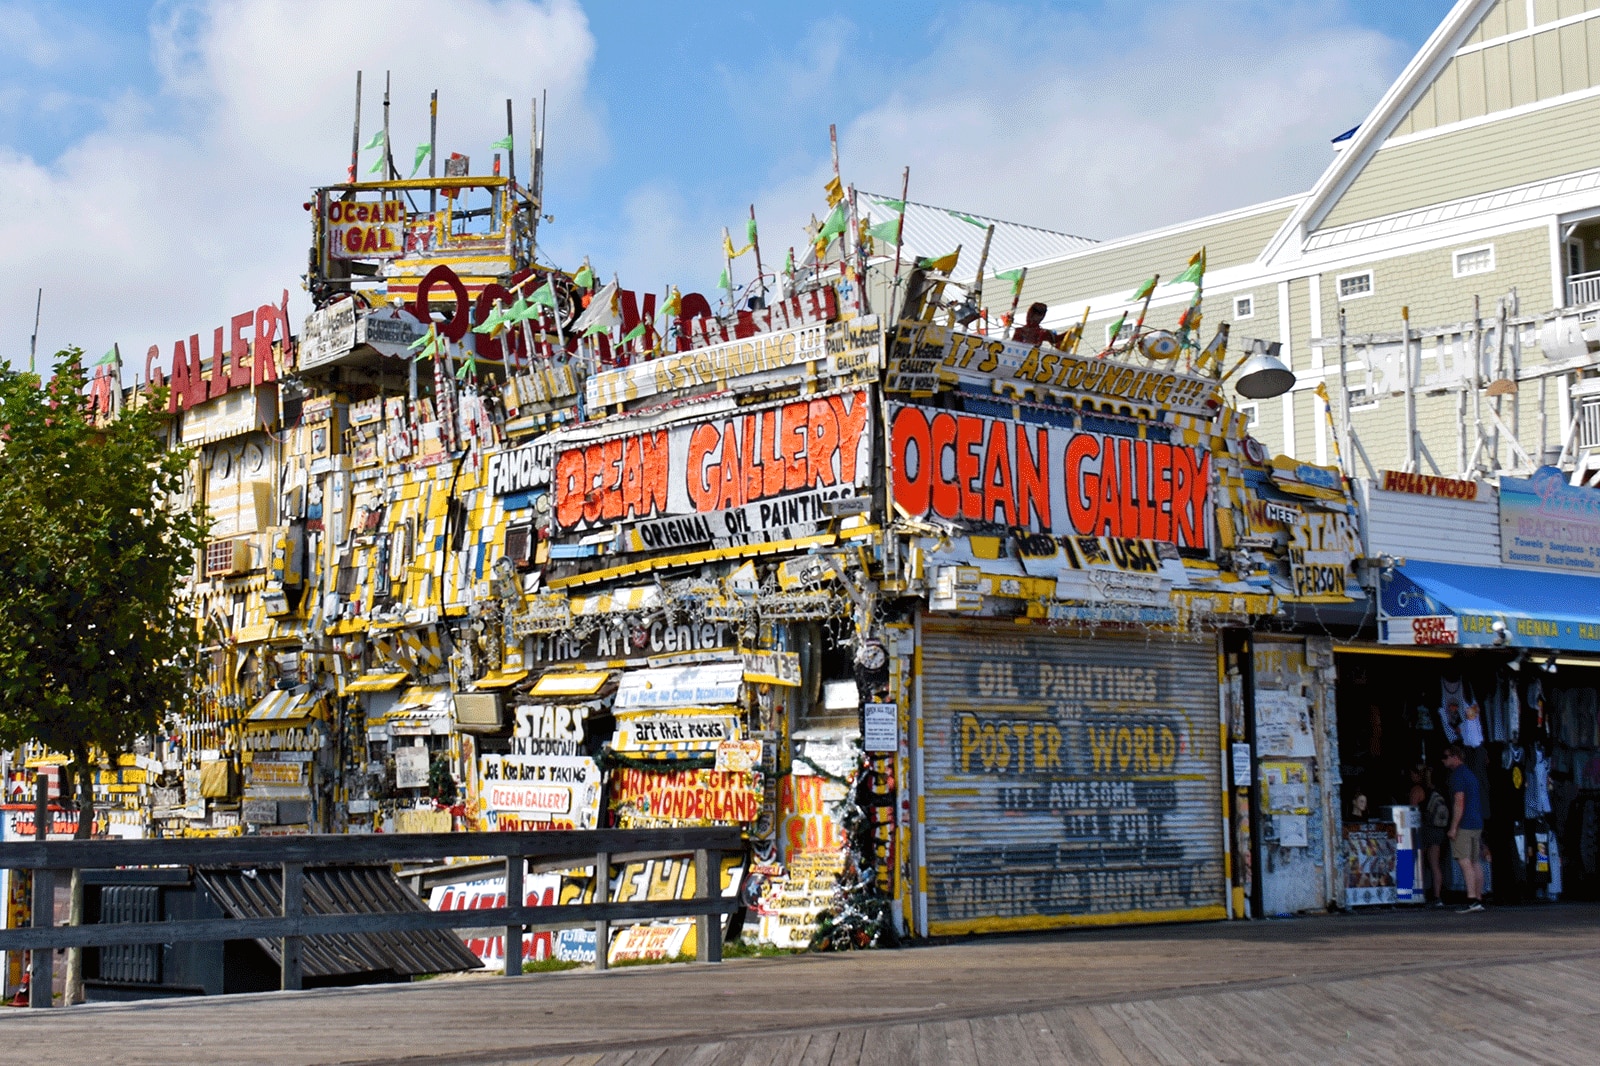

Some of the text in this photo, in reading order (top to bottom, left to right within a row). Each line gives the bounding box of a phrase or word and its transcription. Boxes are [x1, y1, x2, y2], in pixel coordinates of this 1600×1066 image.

[145, 288, 293, 413] GALLERY
[837, 353, 870, 371] GALLERY
[944, 331, 1004, 373] IT'S
[555, 391, 868, 528] OCEAN GALLERY
[892, 406, 1210, 549] OCEAN GALLERY
[1386, 470, 1478, 501] HOLLYWOOD
[640, 514, 715, 549] ORIGINAL
[724, 508, 751, 534] OIL
[1295, 565, 1345, 597] PERSON
[597, 626, 631, 656] Art
[651, 620, 728, 653] Center
[1412, 617, 1446, 631] OCEAN
[1414, 630, 1458, 645] GALLERY
[1460, 616, 1493, 633] VAPE
[1517, 619, 1559, 637] HENNA
[978, 661, 1158, 701] OIL PAINTINGS
[635, 719, 723, 740] art that rocks
[960, 713, 1064, 774] POSTER
[1088, 723, 1176, 773] WORLD
[484, 760, 499, 780] JOE
[538, 765, 546, 780] IS
[549, 766, 587, 783] TAKING
[612, 768, 699, 800] CHRISTMAS
[492, 789, 568, 809] OCEAN GALLERY
[650, 788, 758, 821] WONDERLAND
[778, 775, 826, 817] ART
[487, 810, 498, 825] TO
[559, 942, 597, 963] faceboo
[647, 937, 666, 948] LIVE
